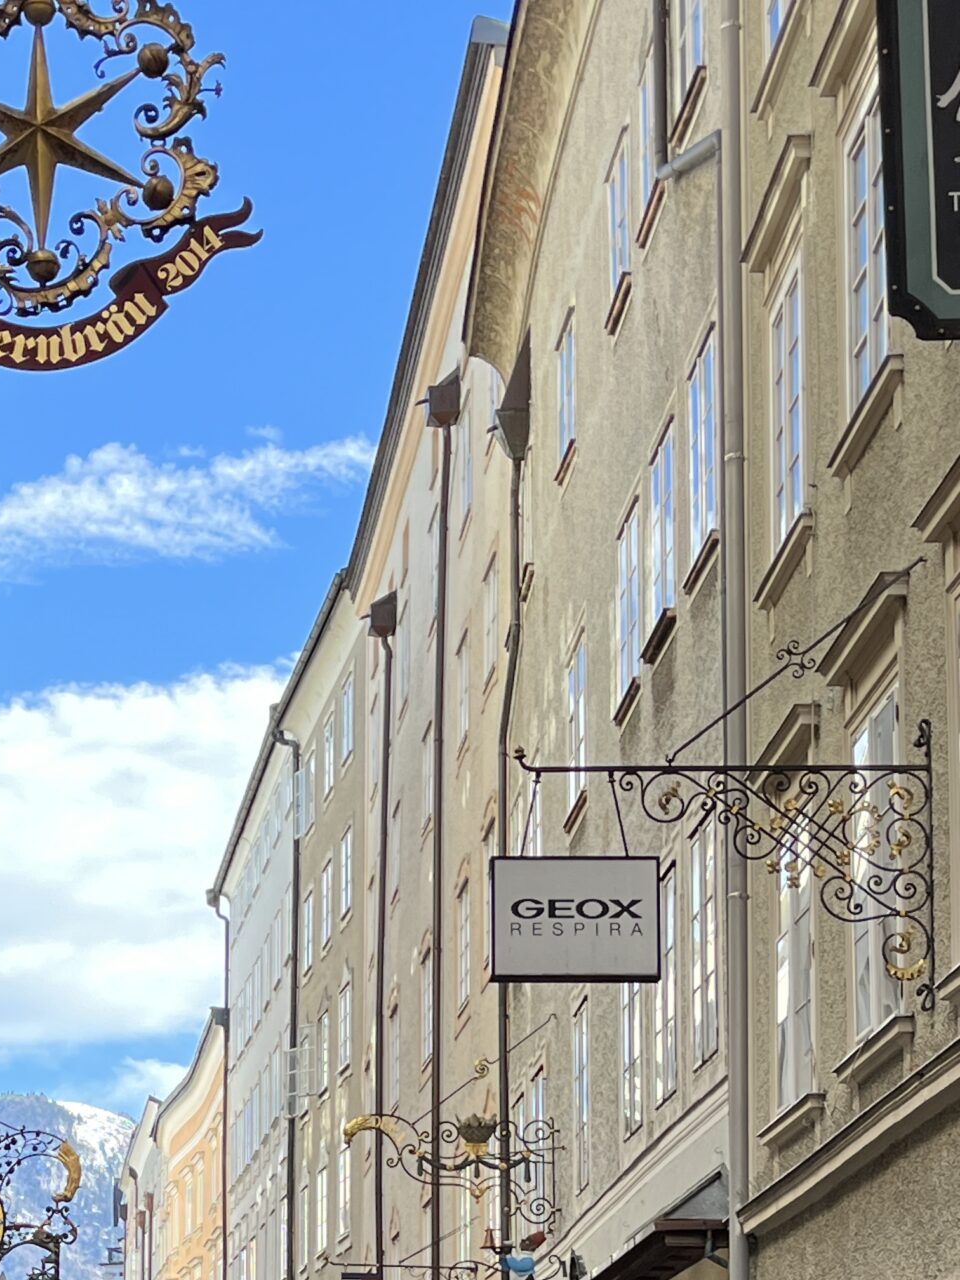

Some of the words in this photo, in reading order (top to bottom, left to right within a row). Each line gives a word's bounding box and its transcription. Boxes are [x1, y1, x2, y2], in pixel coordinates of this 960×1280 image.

[157, 225, 226, 291] 2014
[510, 898, 643, 919] GEOX
[510, 922, 644, 936] RESPIRA
